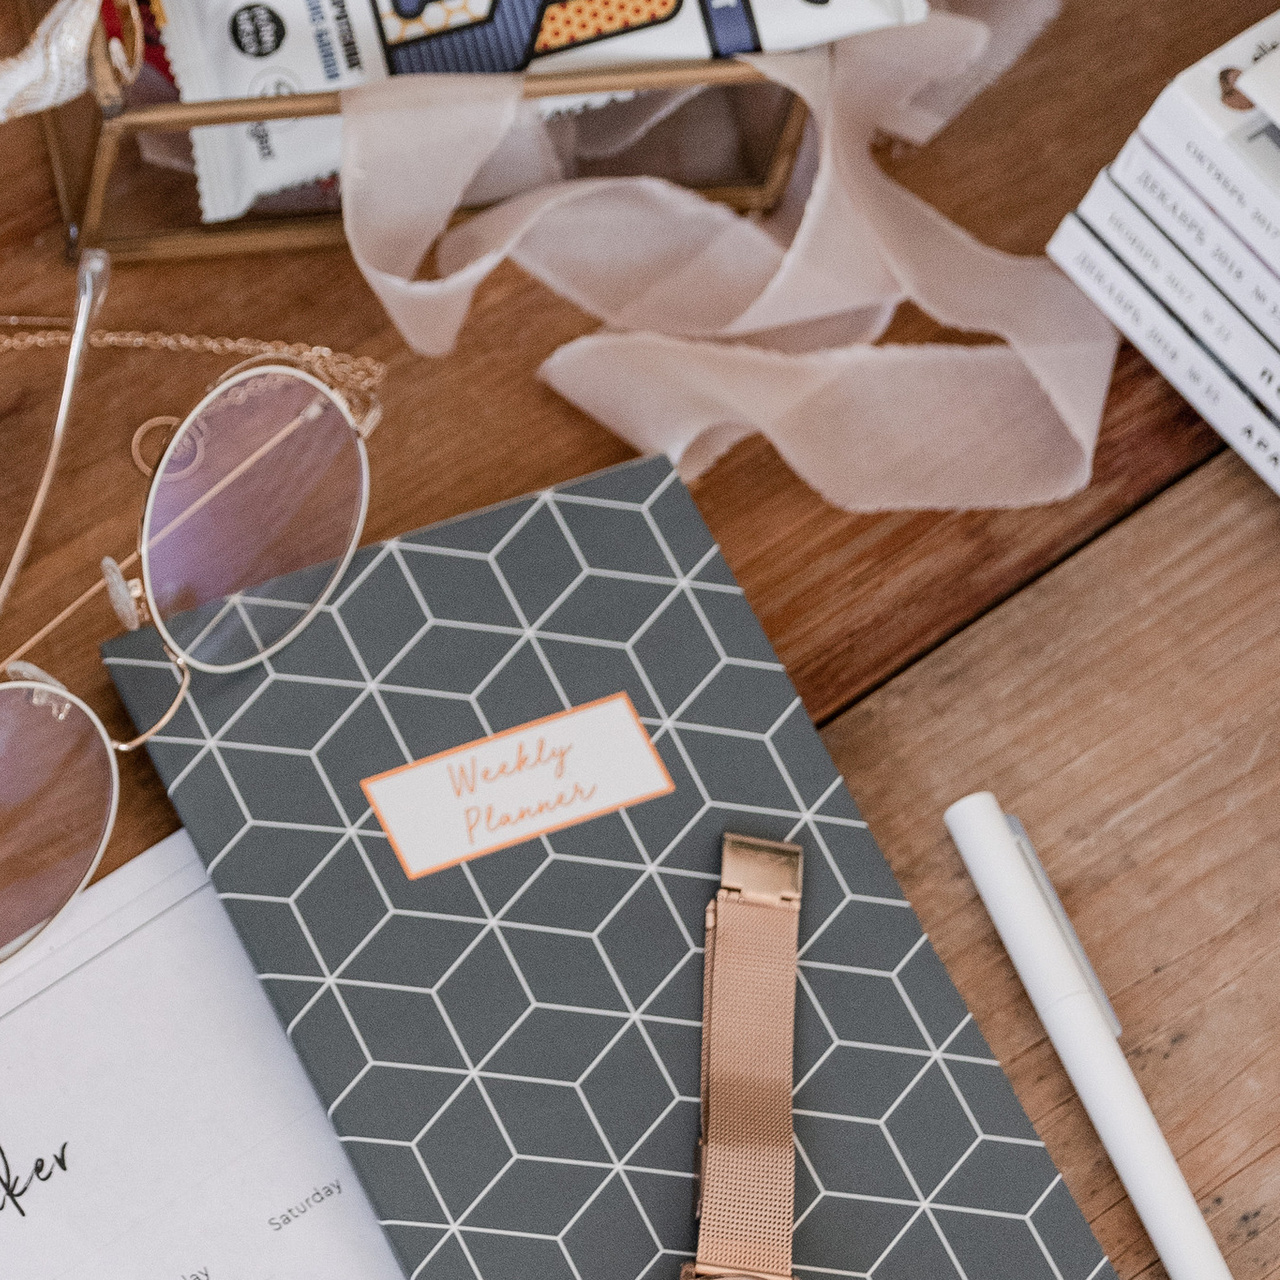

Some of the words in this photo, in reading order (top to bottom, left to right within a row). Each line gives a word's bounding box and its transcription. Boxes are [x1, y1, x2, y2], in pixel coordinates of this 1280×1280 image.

[447, 737, 573, 798] Weekly
[465, 783, 598, 846] Planner
[267, 1178, 343, 1231] Saturday
